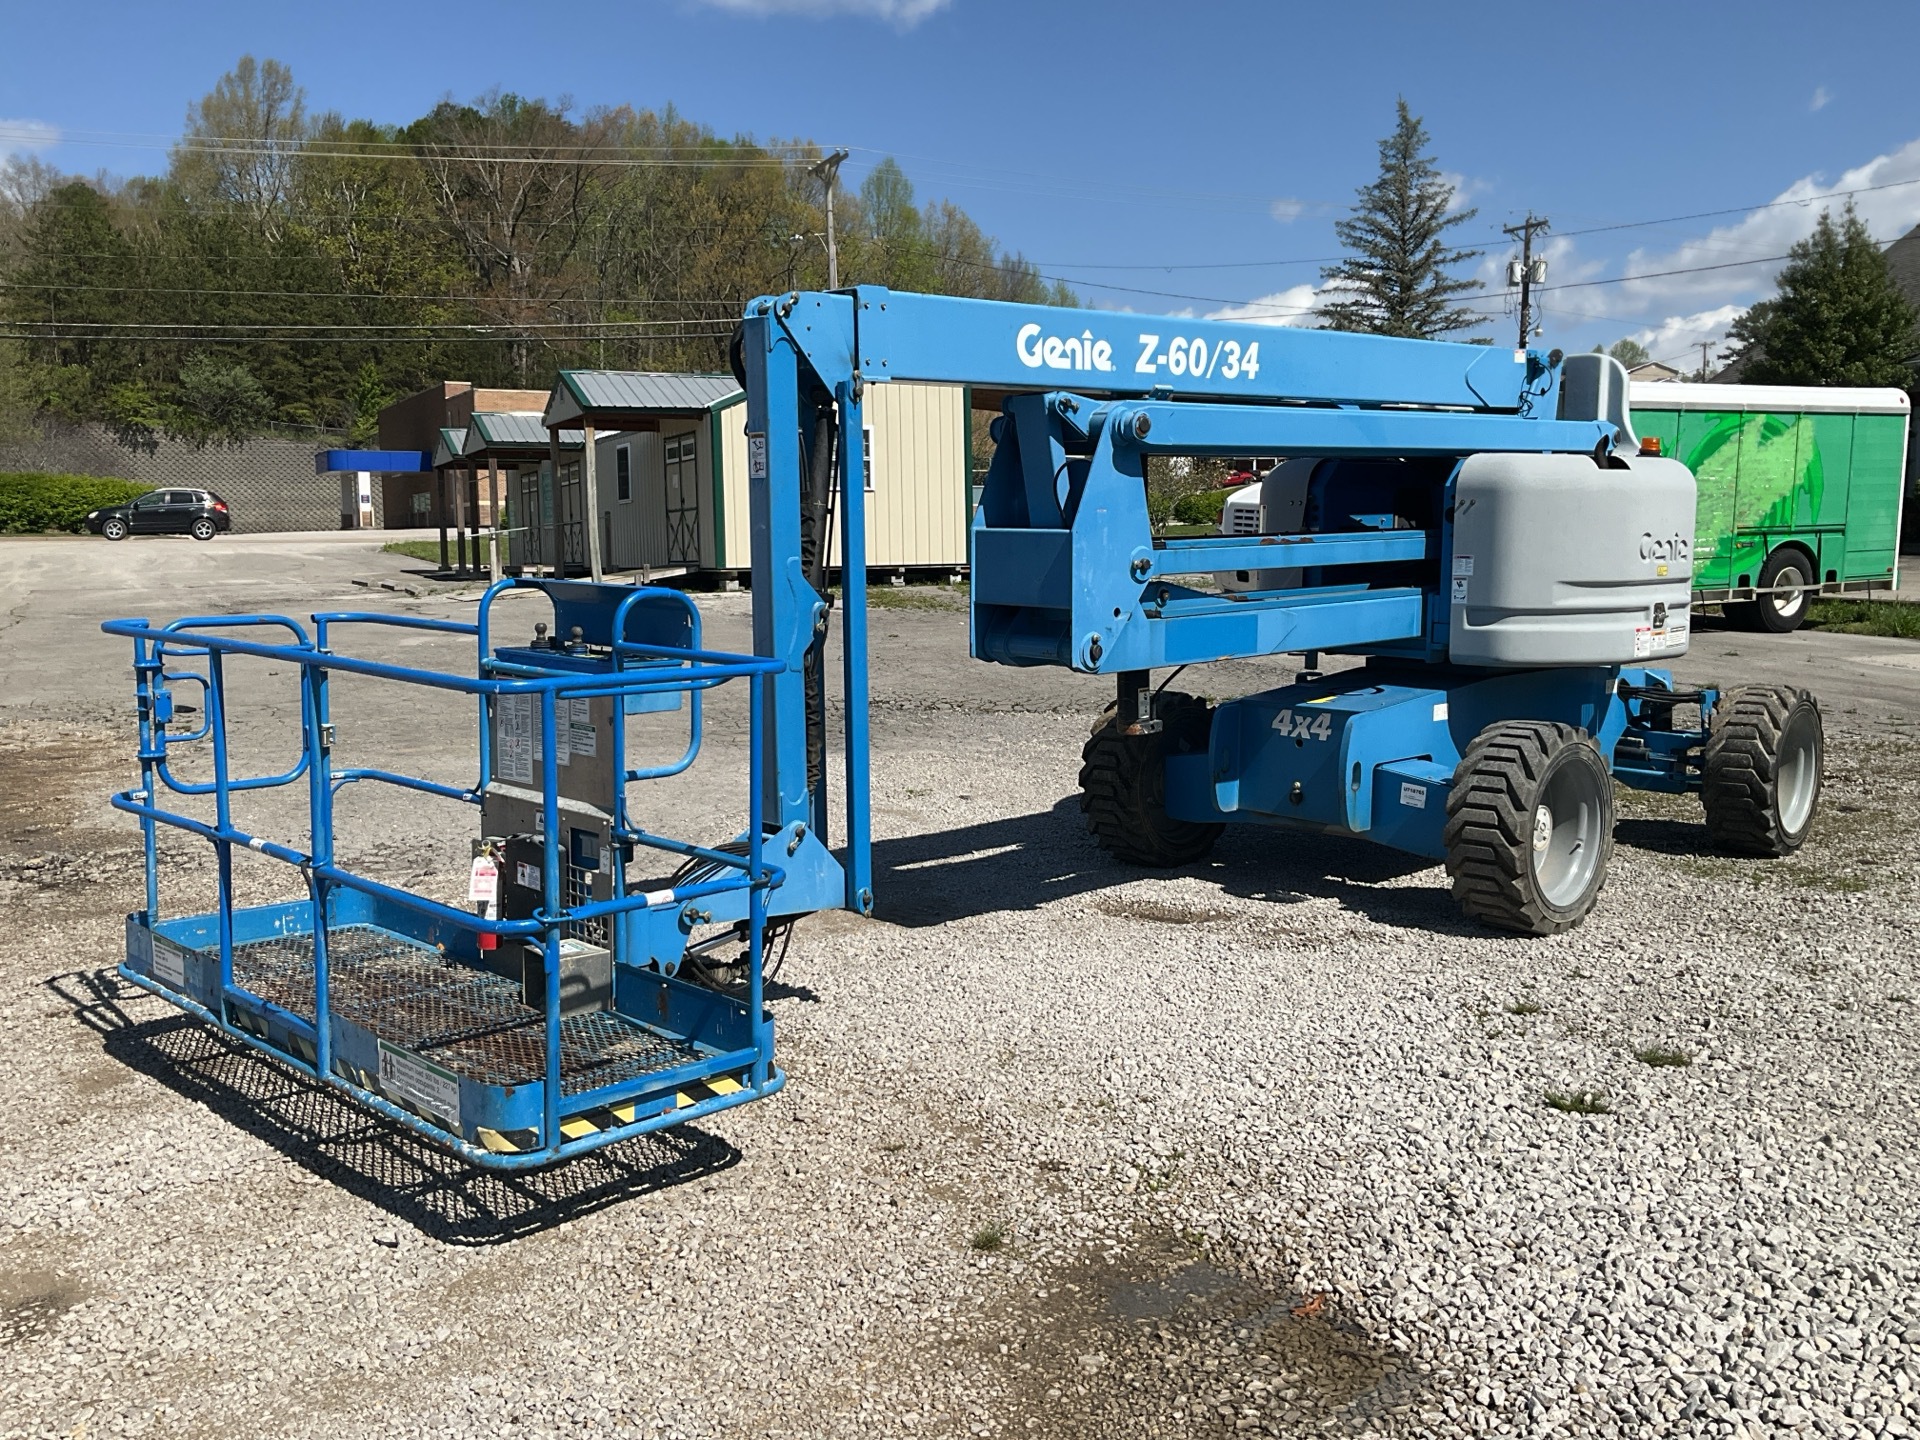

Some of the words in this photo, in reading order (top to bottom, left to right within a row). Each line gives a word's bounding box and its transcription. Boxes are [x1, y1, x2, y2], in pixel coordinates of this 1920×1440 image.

[1016, 323, 1115, 371] Genie
[1135, 334, 1260, 380] Z-60/34
[1640, 532, 1688, 562] Genie
[1271, 709, 1332, 741] 4x4
